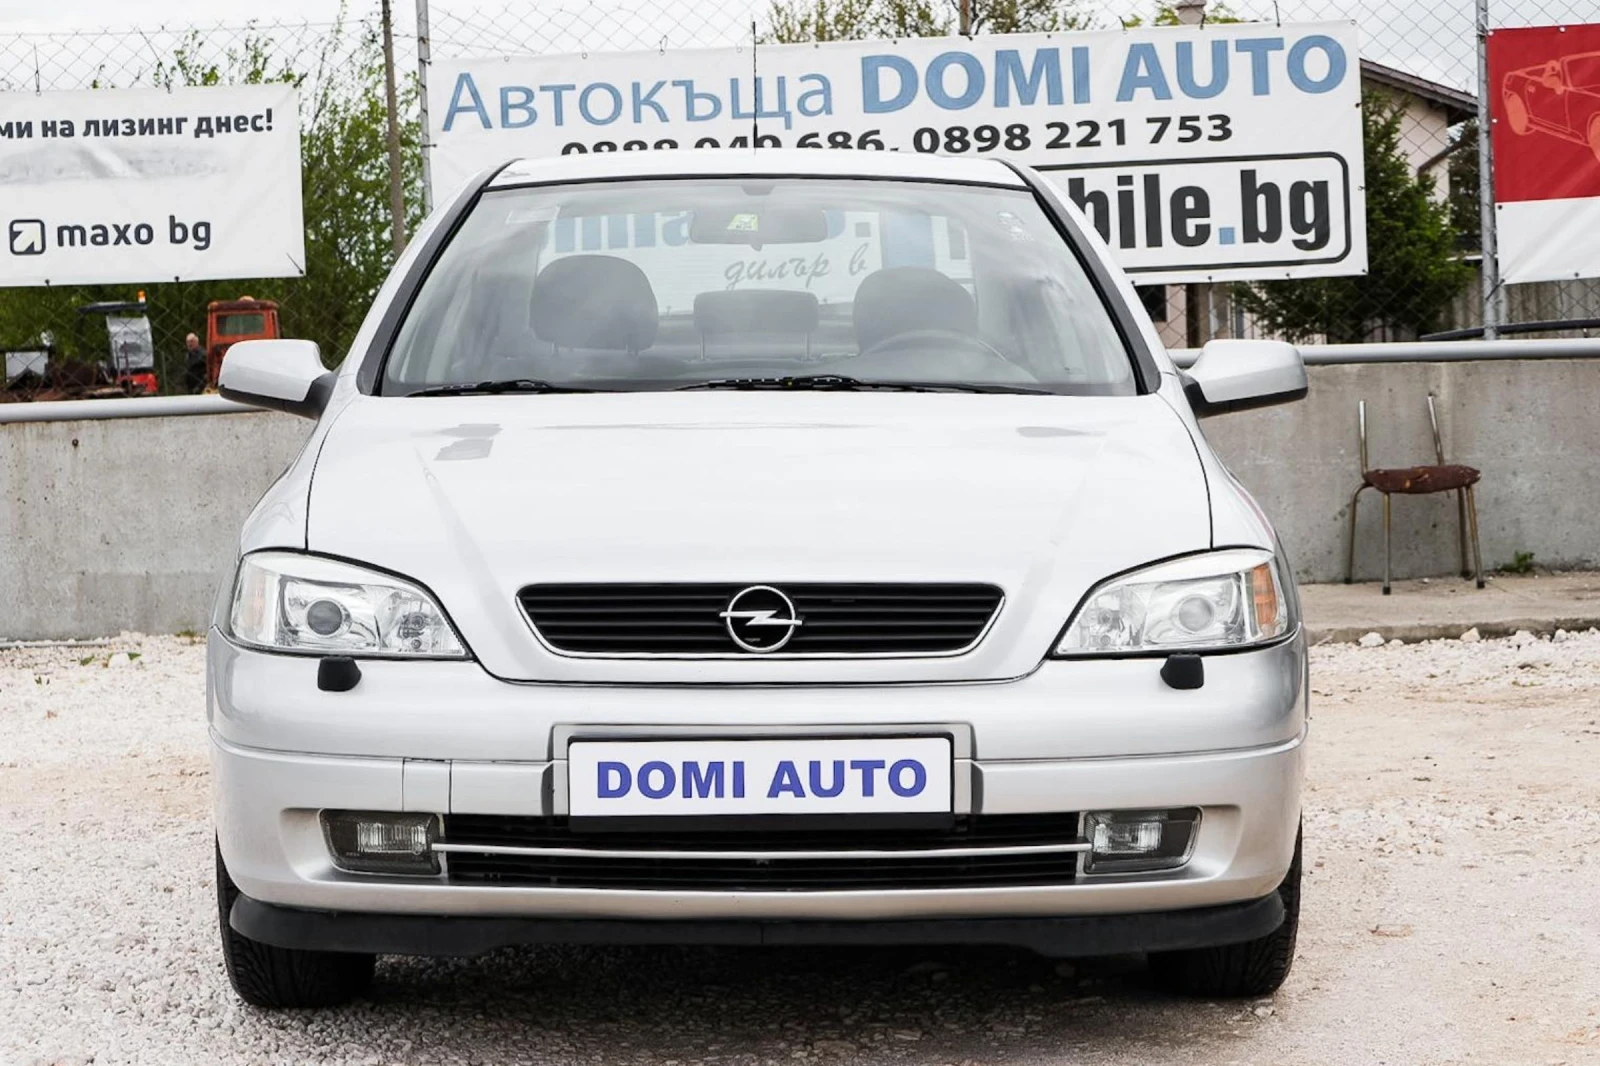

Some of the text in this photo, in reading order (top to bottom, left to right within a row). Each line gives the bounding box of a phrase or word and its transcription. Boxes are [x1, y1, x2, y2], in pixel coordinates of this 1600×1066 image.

[861, 34, 1347, 113] DOMI AUTO
[442, 72, 834, 132] Автокъща
[41, 120, 75, 138] на
[82, 117, 188, 137] лизинг
[194, 108, 273, 138] днес!
[913, 123, 1031, 153] 0898
[1045, 119, 1127, 149] 221
[1146, 114, 1233, 145] 753
[57, 215, 211, 250] maxo bg
[597, 758, 927, 799] DOMI AUTO
